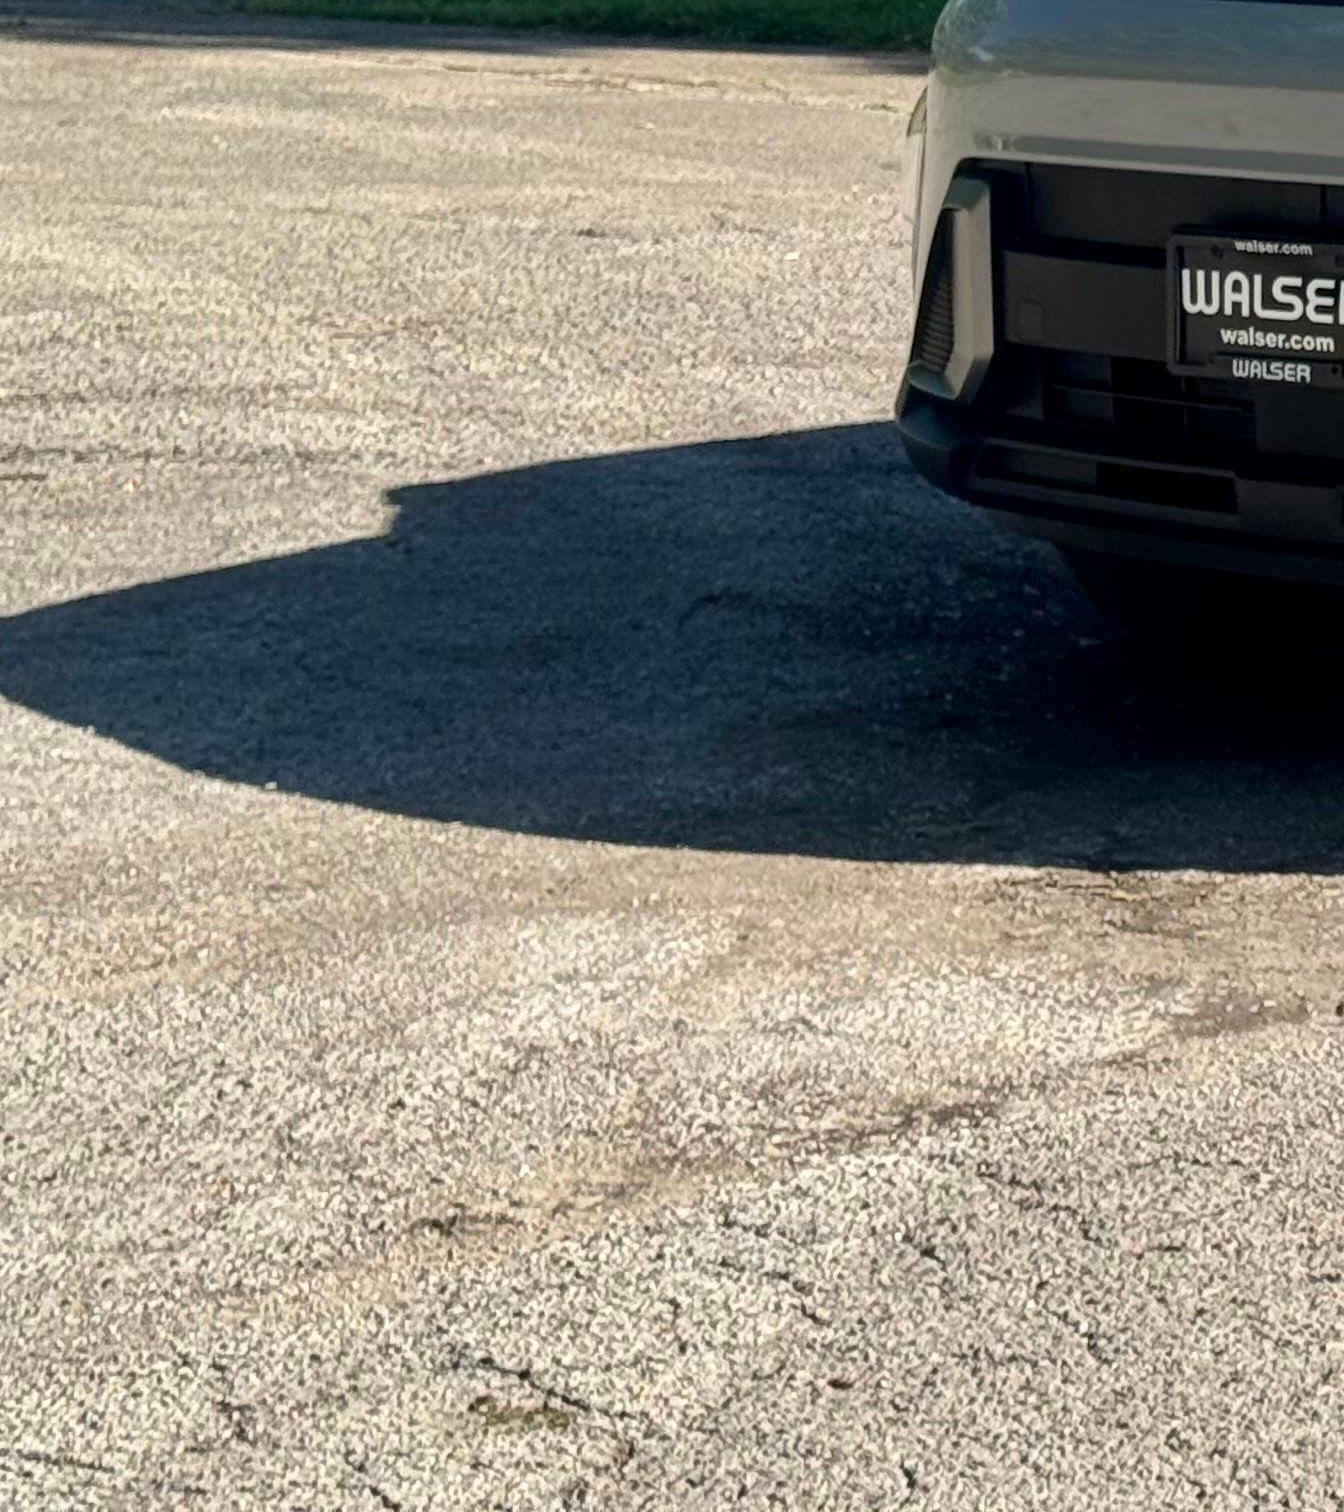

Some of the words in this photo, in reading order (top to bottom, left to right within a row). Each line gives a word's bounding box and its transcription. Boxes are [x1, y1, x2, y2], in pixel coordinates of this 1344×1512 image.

[1234, 239, 1314, 256] walser.com
[1220, 326, 1336, 353] walser.com
[1232, 358, 1312, 384] WALSER
